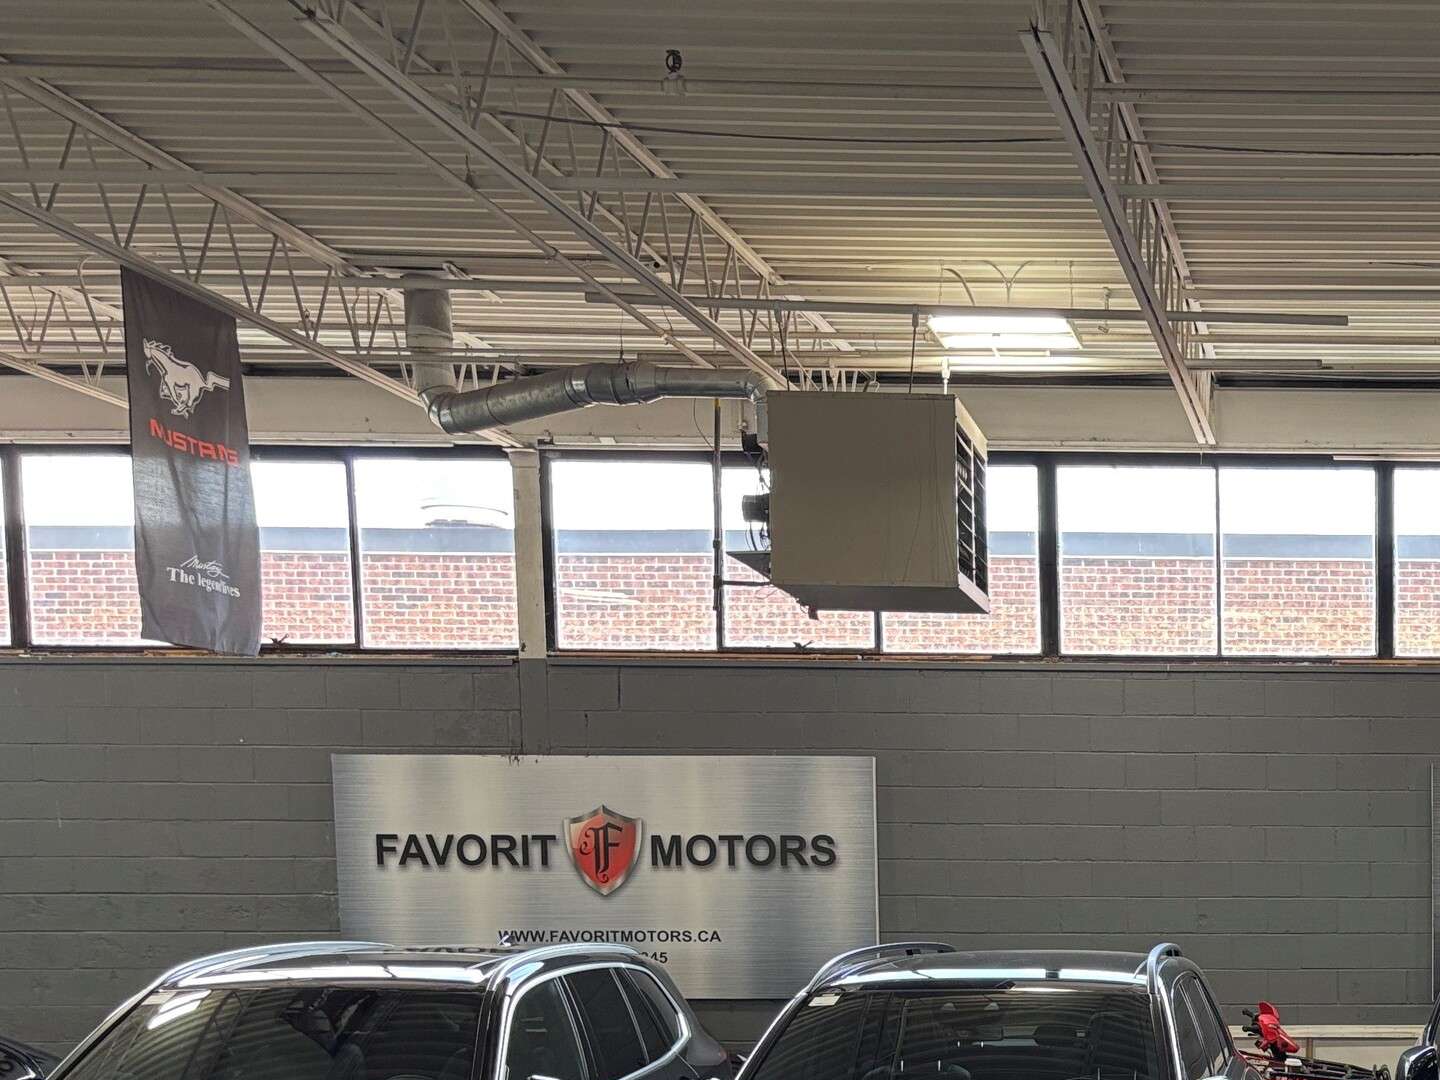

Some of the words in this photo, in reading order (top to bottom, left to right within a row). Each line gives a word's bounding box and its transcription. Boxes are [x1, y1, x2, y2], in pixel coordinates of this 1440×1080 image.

[166, 567, 196, 584] The
[375, 834, 556, 866] FAVORIT
[650, 834, 837, 867] MOTORS
[499, 930, 722, 943] WWW.FAVORITMOTORS.CA
